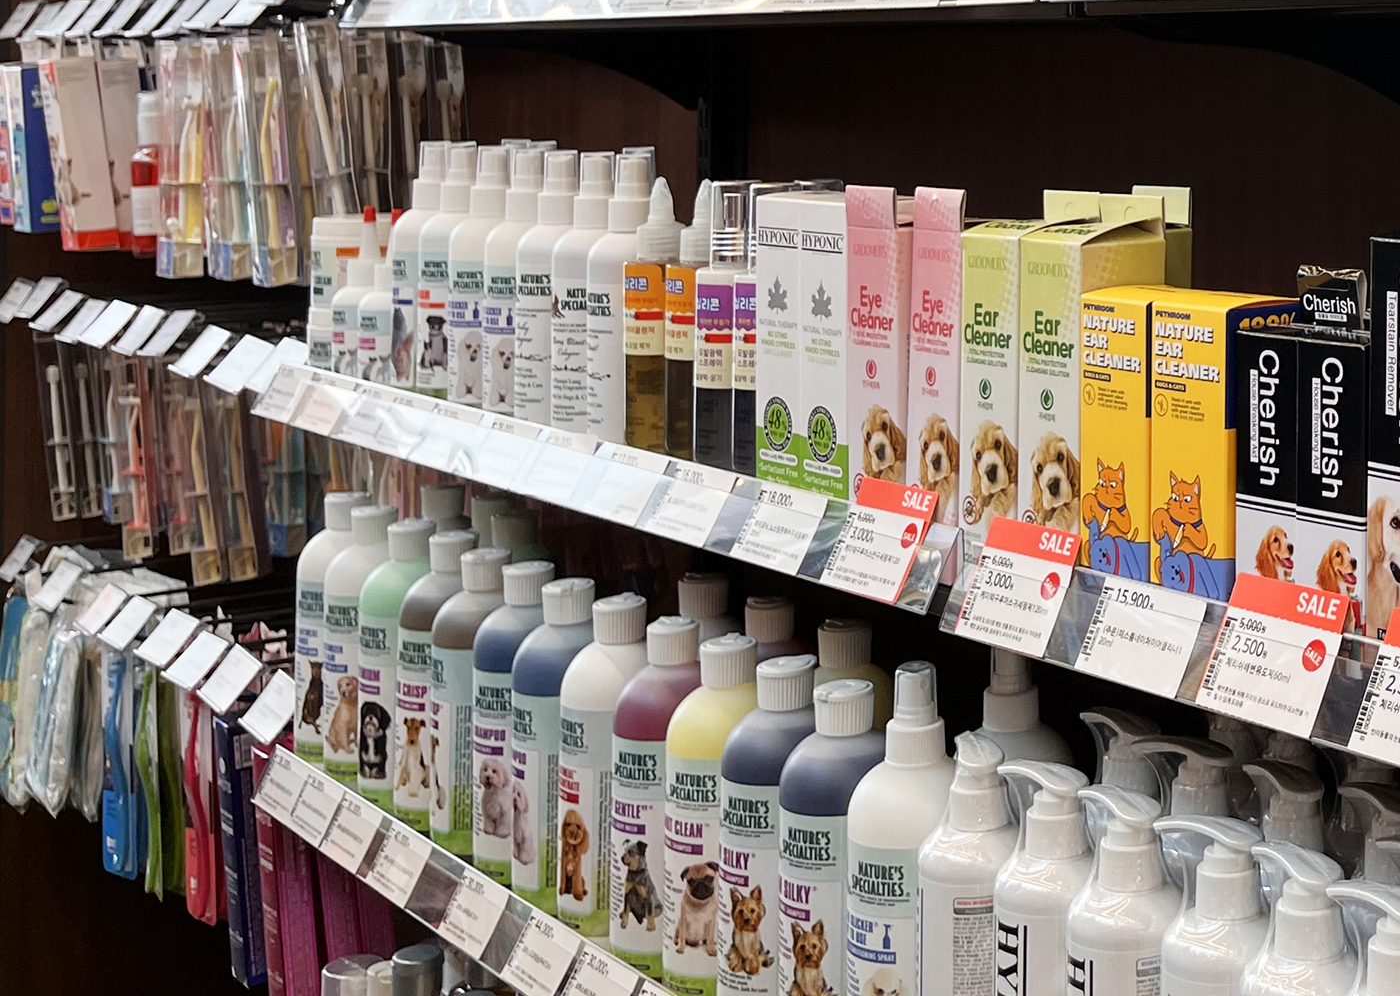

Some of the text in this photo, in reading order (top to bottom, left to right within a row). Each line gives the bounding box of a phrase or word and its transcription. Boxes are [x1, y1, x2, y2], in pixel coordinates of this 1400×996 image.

[758, 228, 799, 246] HYPONIC
[860, 285, 882, 310] Eye
[1302, 292, 1358, 316] Cherish
[851, 308, 894, 332] Cleaner
[974, 303, 999, 327] Ear
[1034, 311, 1061, 337] Ear
[964, 324, 1012, 350] Cleaner
[1155, 320, 1214, 344] NATURE
[1023, 332, 1075, 360] Cleaner
[1155, 341, 1184, 360] EAR
[1386, 295, 1398, 413] Tearstain Remover
[1154, 358, 1221, 384] CLEANER
[1258, 349, 1280, 488] Cherish
[1038, 530, 1075, 557] SALE
[1296, 590, 1342, 622] SALE
[402, 683, 428, 698] CRISP
[619, 753, 658, 768] NATURE'S
[614, 765, 658, 782] SPECIALTIES
[675, 820, 704, 839] CLEAN
[858, 859, 905, 882] NATURE'S
[783, 884, 812, 905] SILKY
[852, 876, 905, 899] SPECIALTIES
